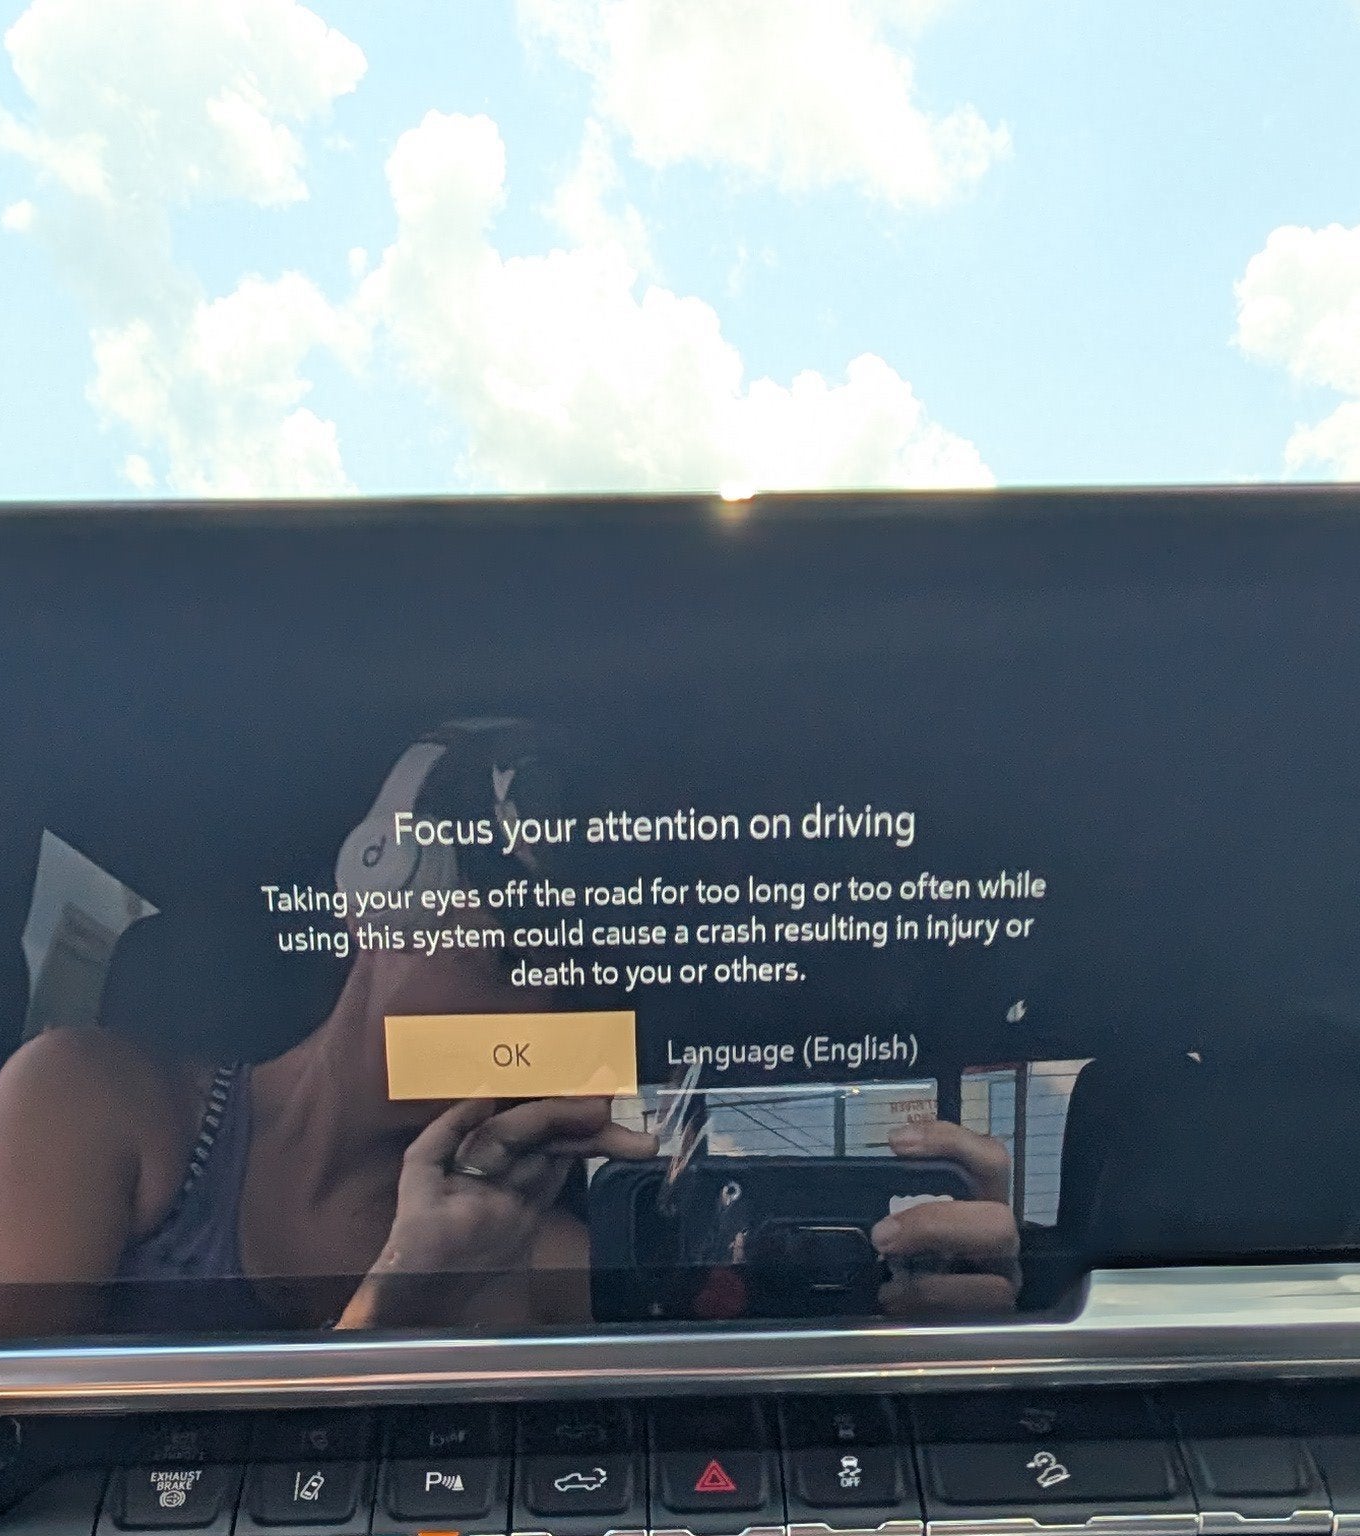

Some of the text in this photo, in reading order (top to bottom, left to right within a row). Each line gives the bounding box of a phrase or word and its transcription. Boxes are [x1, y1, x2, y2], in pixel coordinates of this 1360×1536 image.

[394, 803, 915, 854] Focus your attention on driving
[261, 870, 1047, 918] Taking your eyes off the road for too long or too often while
[278, 913, 1034, 958] using this system could cause a crash resulting in injury or
[511, 955, 806, 991] death to you or others.
[493, 1043, 531, 1067] OK
[667, 1034, 918, 1071] Language (English)
[150, 1470, 202, 1482] EXHAUST
[156, 1480, 193, 1491] BRAKE
[840, 1477, 861, 1488] OFF
